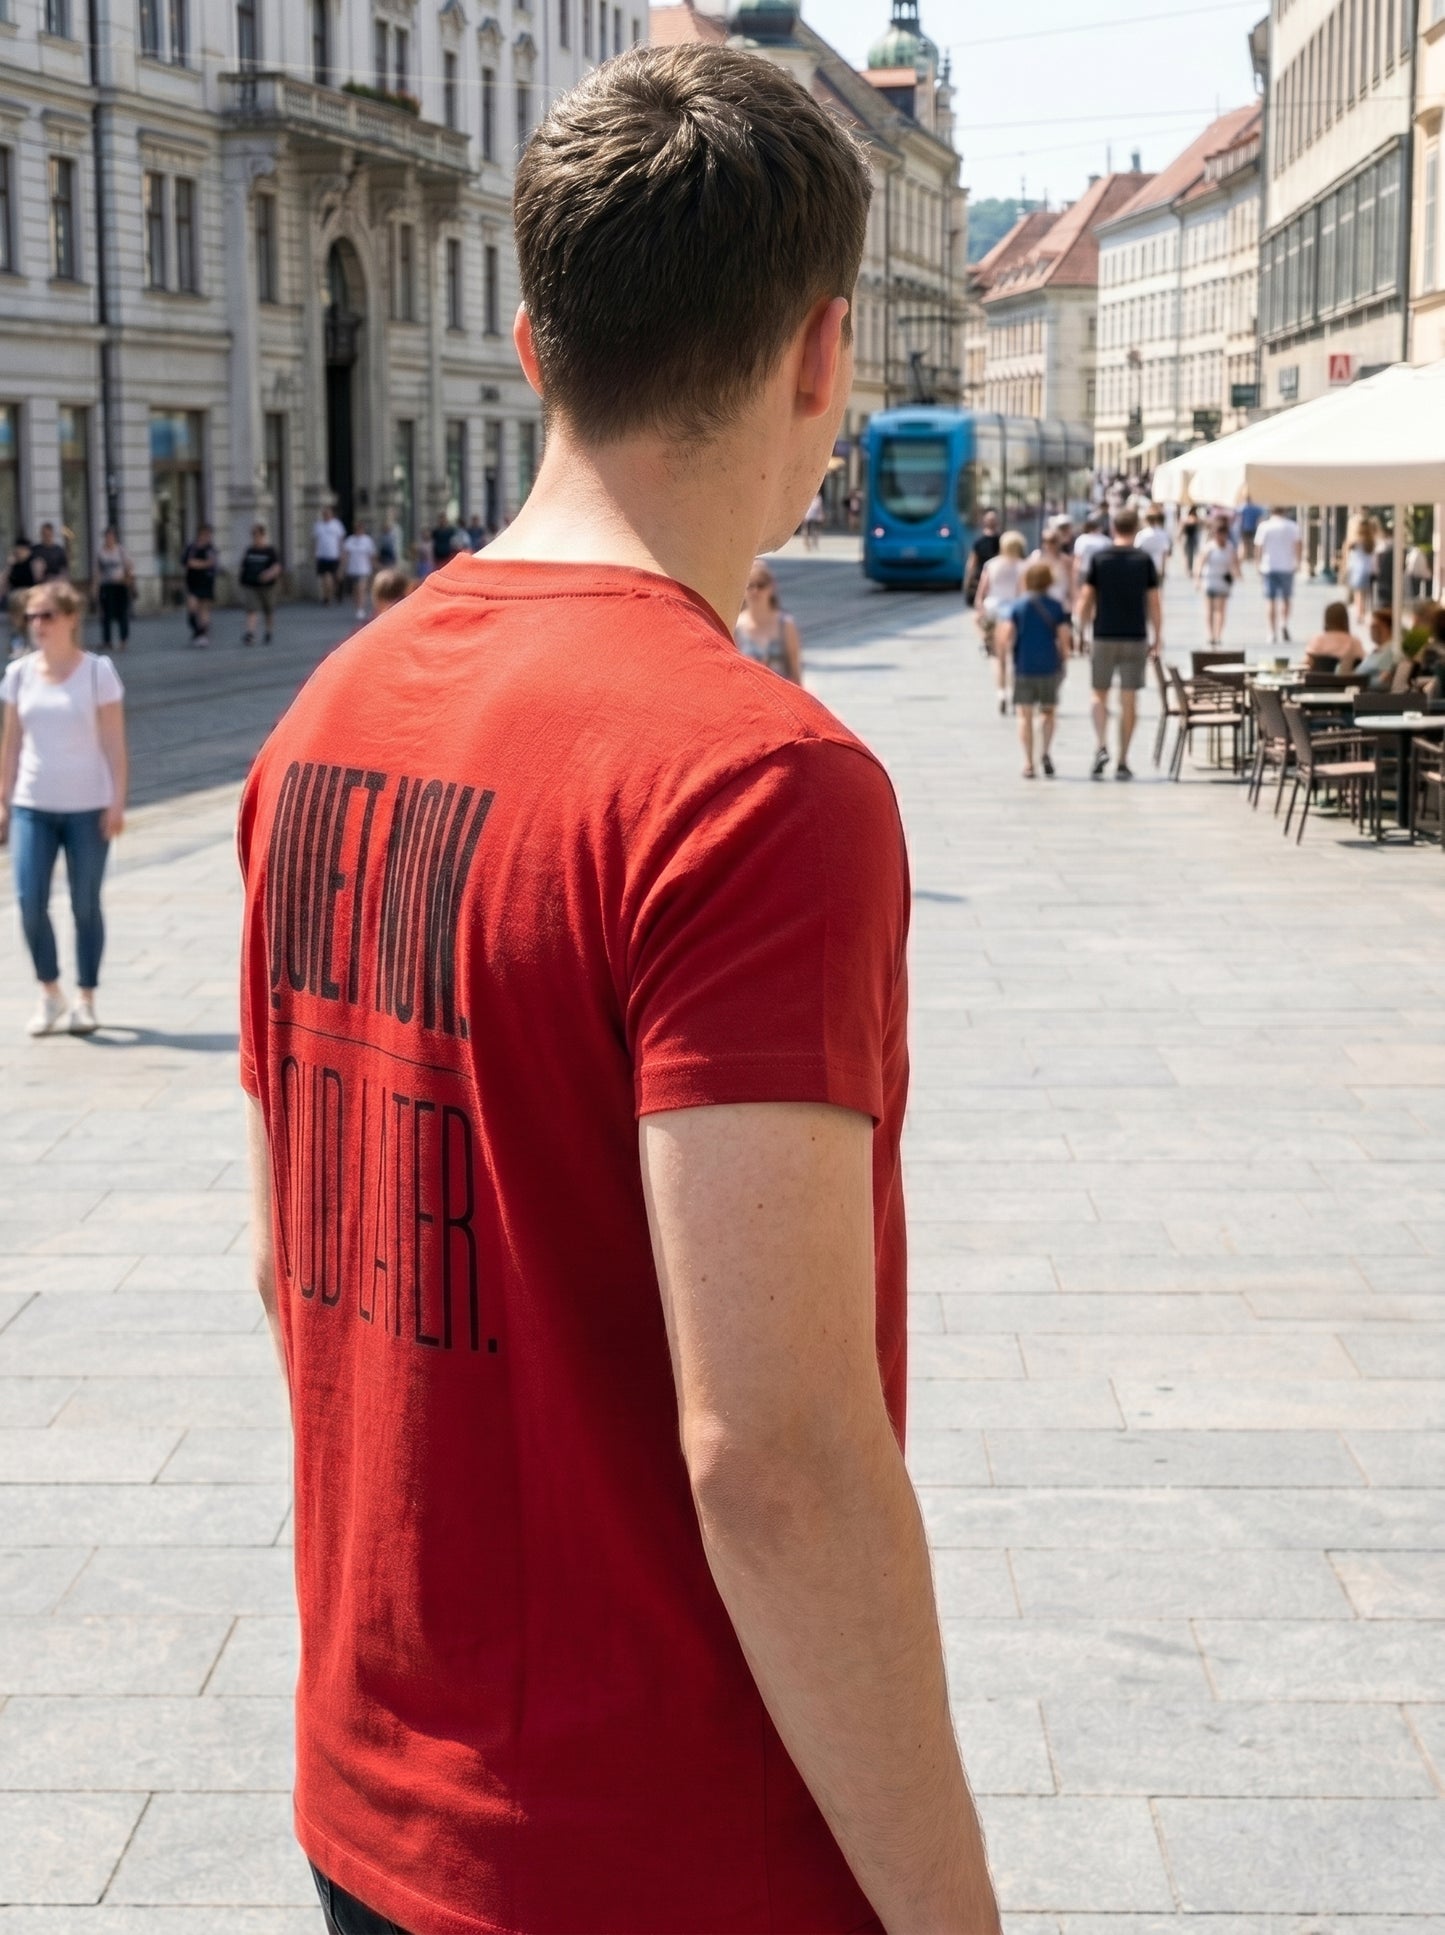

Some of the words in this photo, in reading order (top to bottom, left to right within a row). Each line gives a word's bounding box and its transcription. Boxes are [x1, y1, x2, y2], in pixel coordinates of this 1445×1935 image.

[266, 761, 387, 1010] QUIET
[375, 775, 496, 1040] NOW.
[359, 1078, 498, 1353] LATER.
